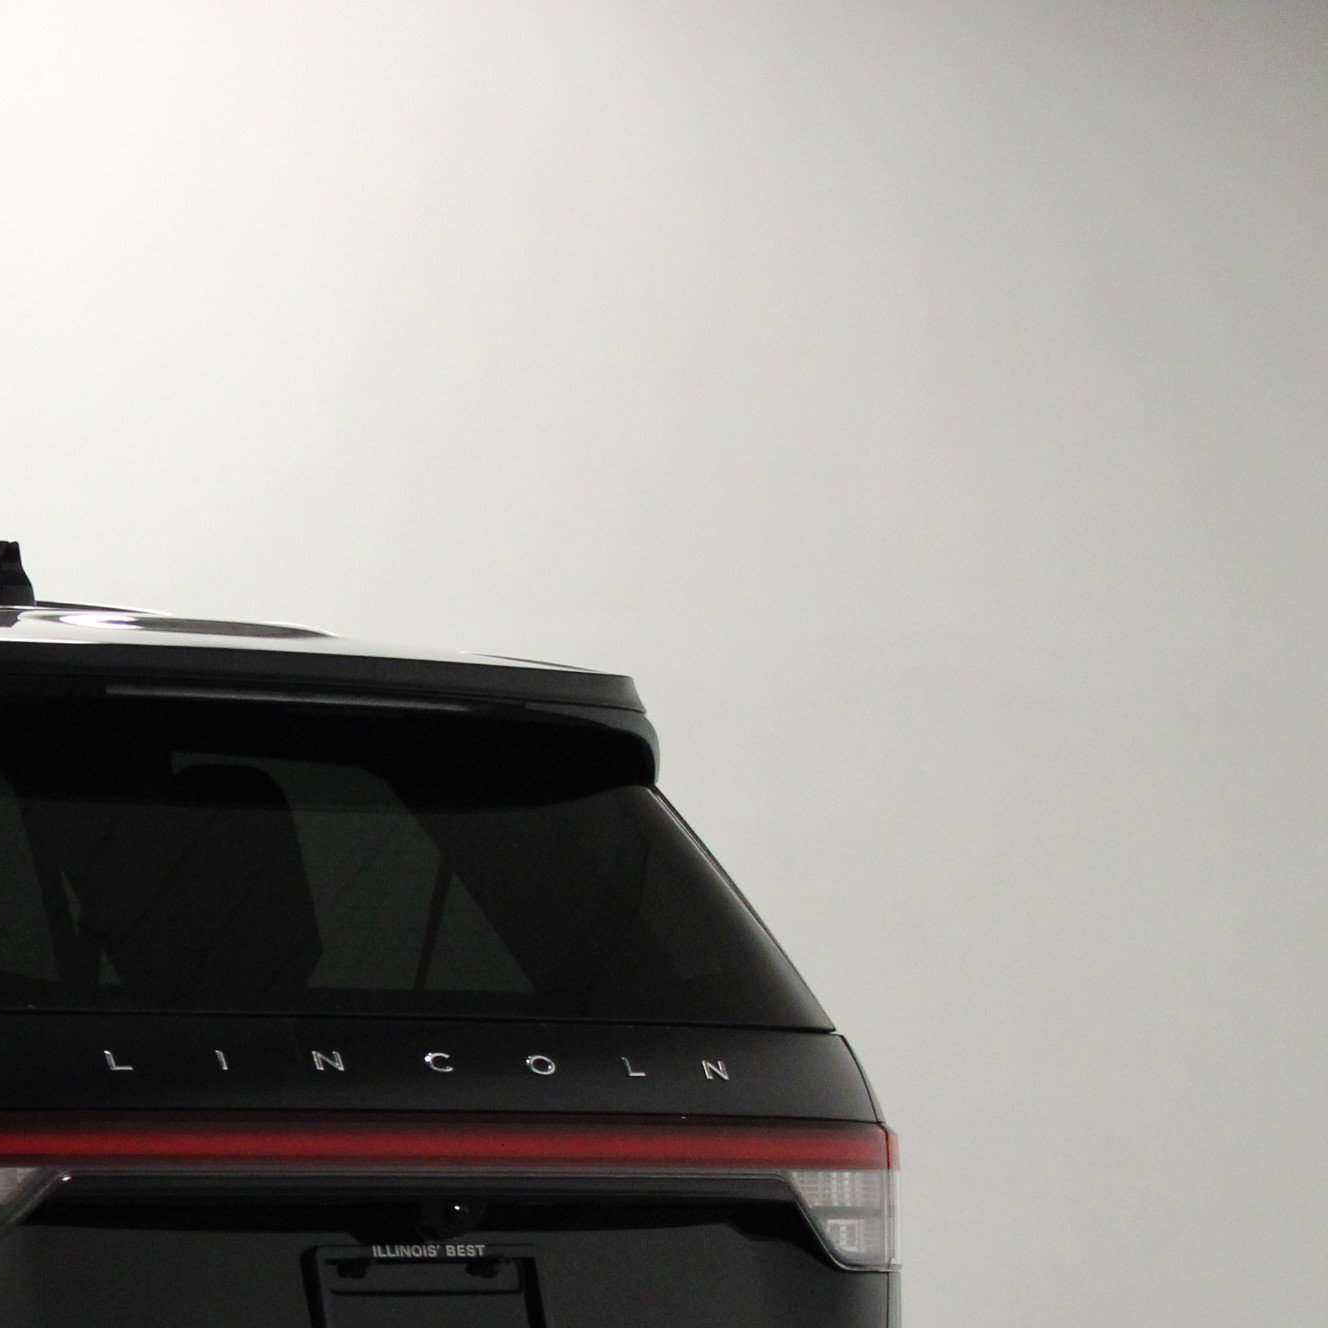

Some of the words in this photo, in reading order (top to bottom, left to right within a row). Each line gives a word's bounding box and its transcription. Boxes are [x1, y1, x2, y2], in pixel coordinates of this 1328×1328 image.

[103, 1049, 730, 1081] LINCOLN
[372, 1244, 441, 1258] ILLINOIS'
[445, 1243, 486, 1257] BEST
